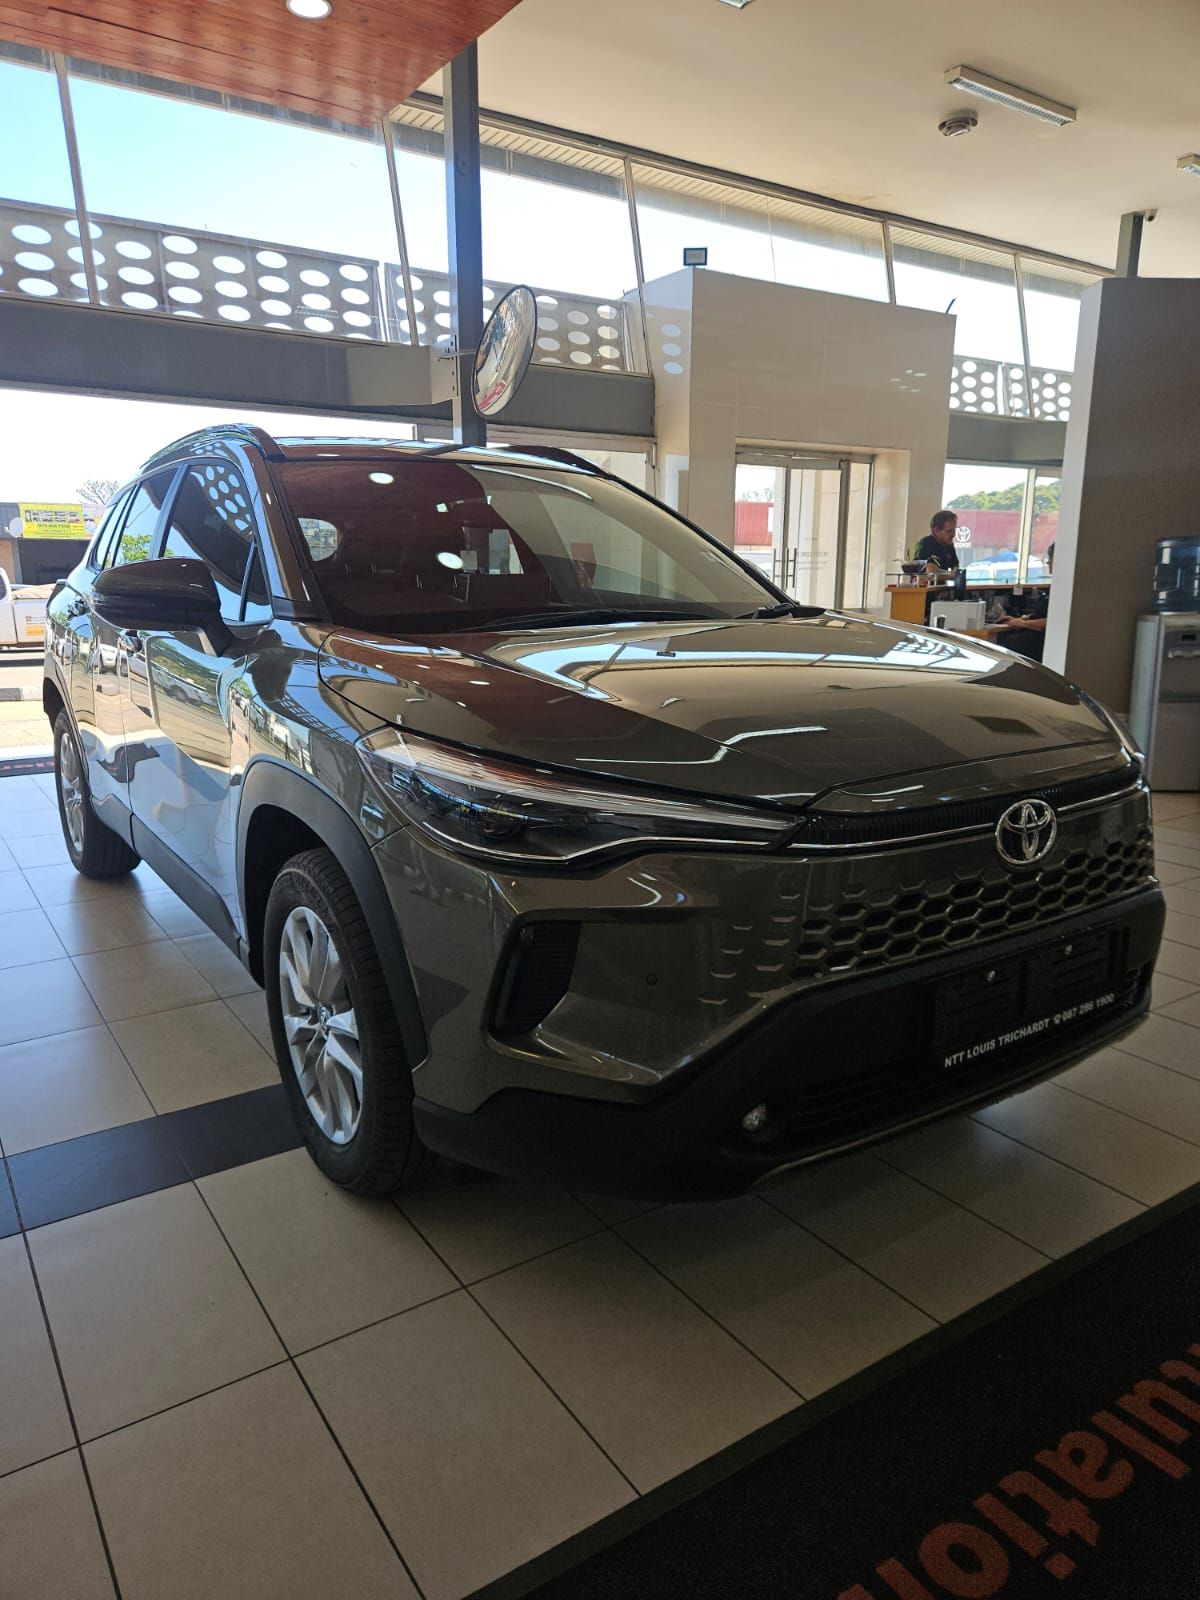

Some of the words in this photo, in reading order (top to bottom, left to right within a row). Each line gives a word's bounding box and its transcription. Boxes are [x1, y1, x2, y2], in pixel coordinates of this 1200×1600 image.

[944, 1051, 965, 1068] NTT
[967, 1039, 996, 1060] LOUIS
[998, 1018, 1050, 1047] TRICHARDT
